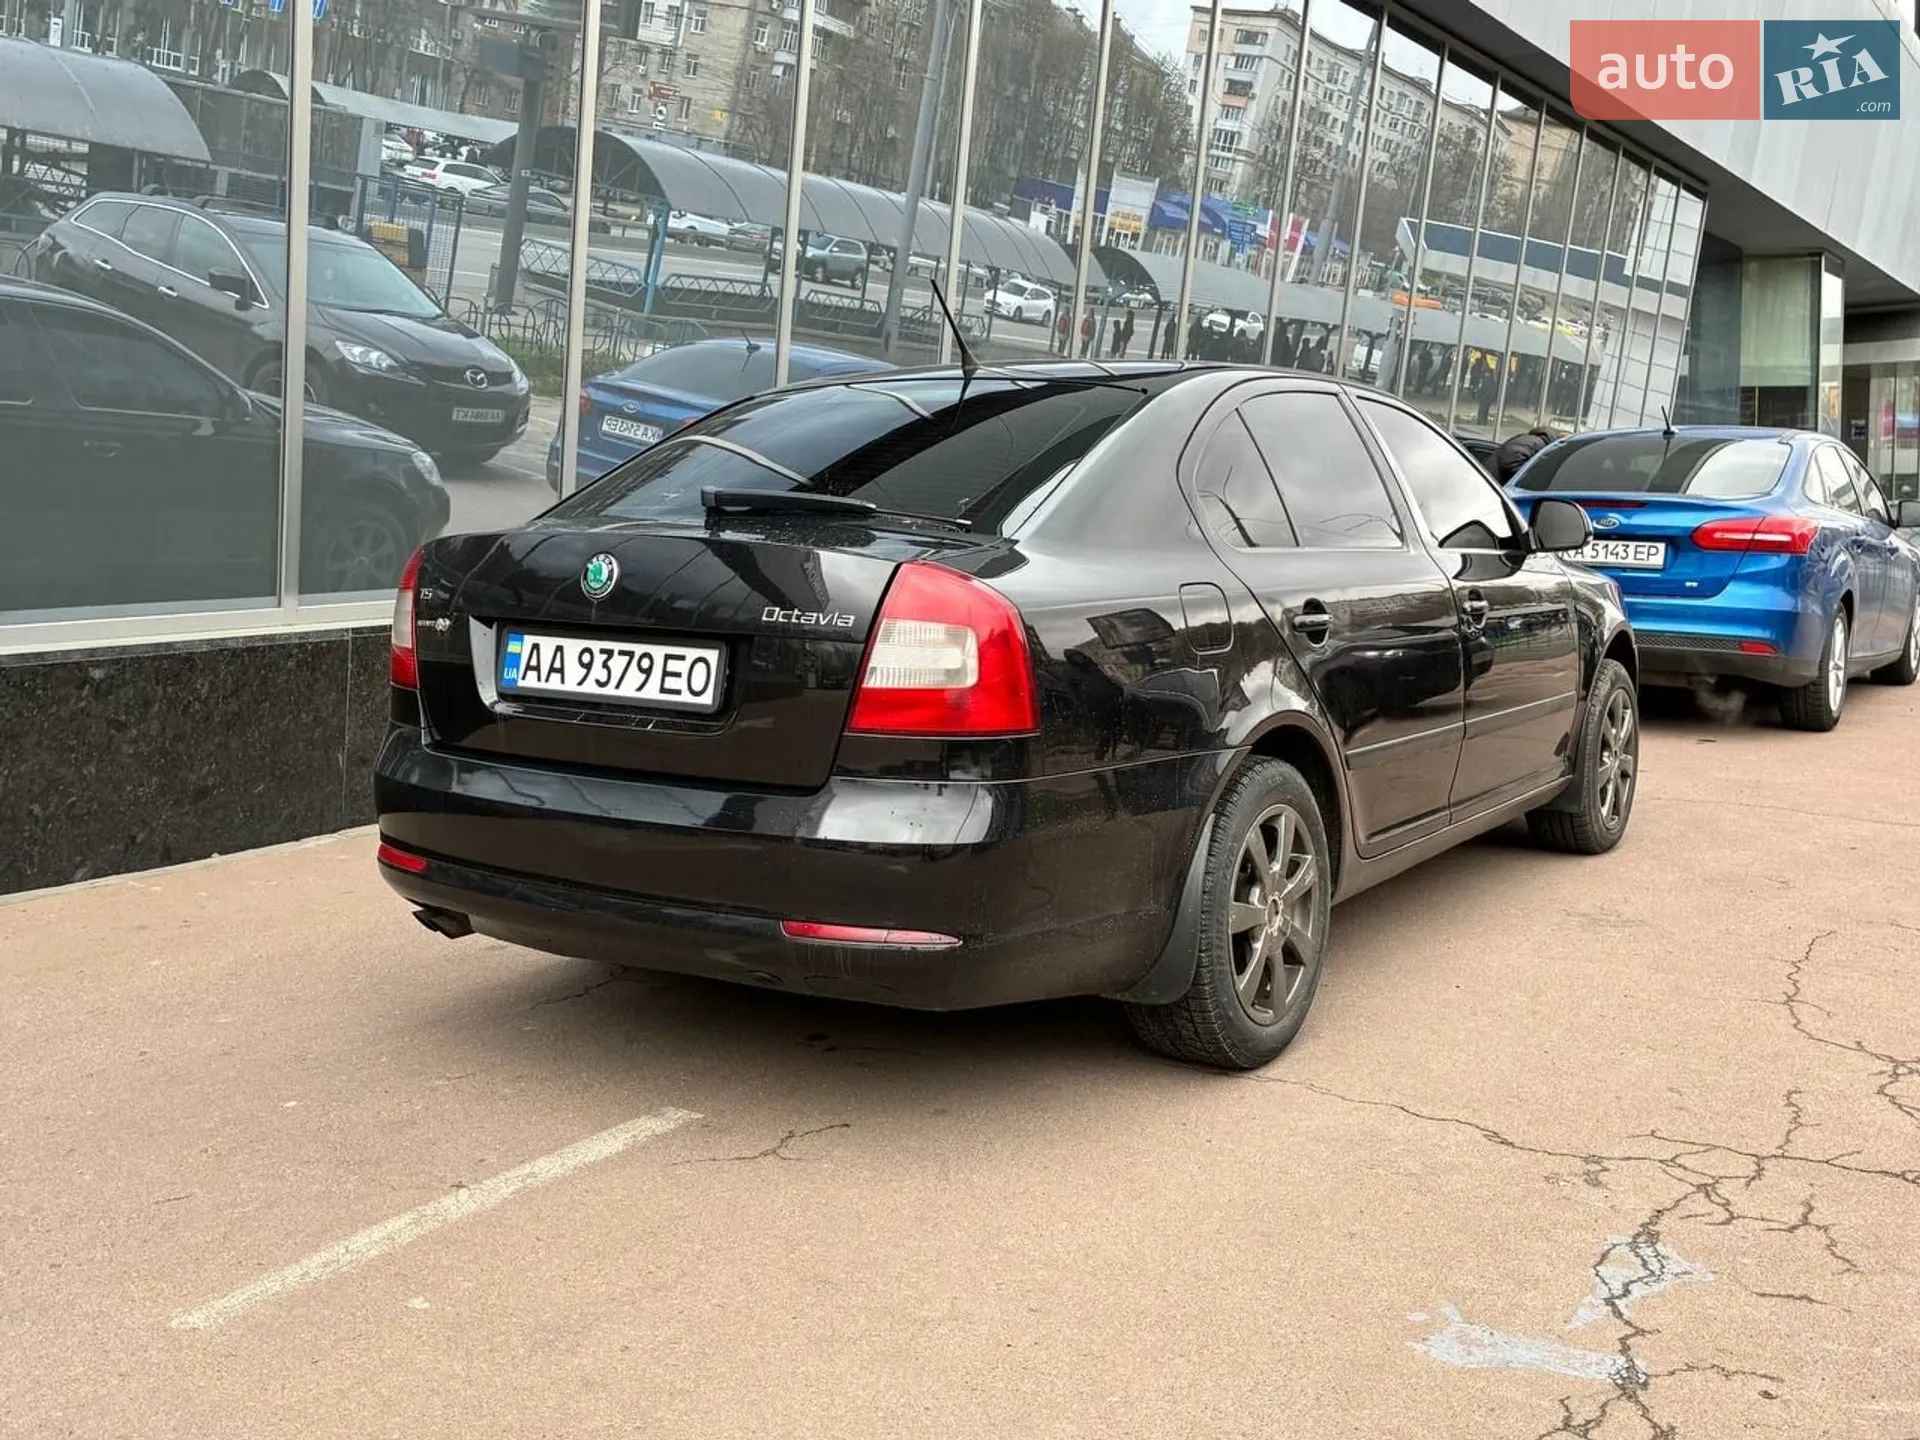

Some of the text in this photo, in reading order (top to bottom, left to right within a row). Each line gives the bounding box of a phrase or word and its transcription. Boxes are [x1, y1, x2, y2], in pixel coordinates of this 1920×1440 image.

[1590, 543, 1630, 560] 5143
[1634, 545, 1659, 561] EP
[762, 606, 855, 627] Octavia
[504, 667, 518, 680] UA
[521, 643, 711, 697] AA 9379 EO
